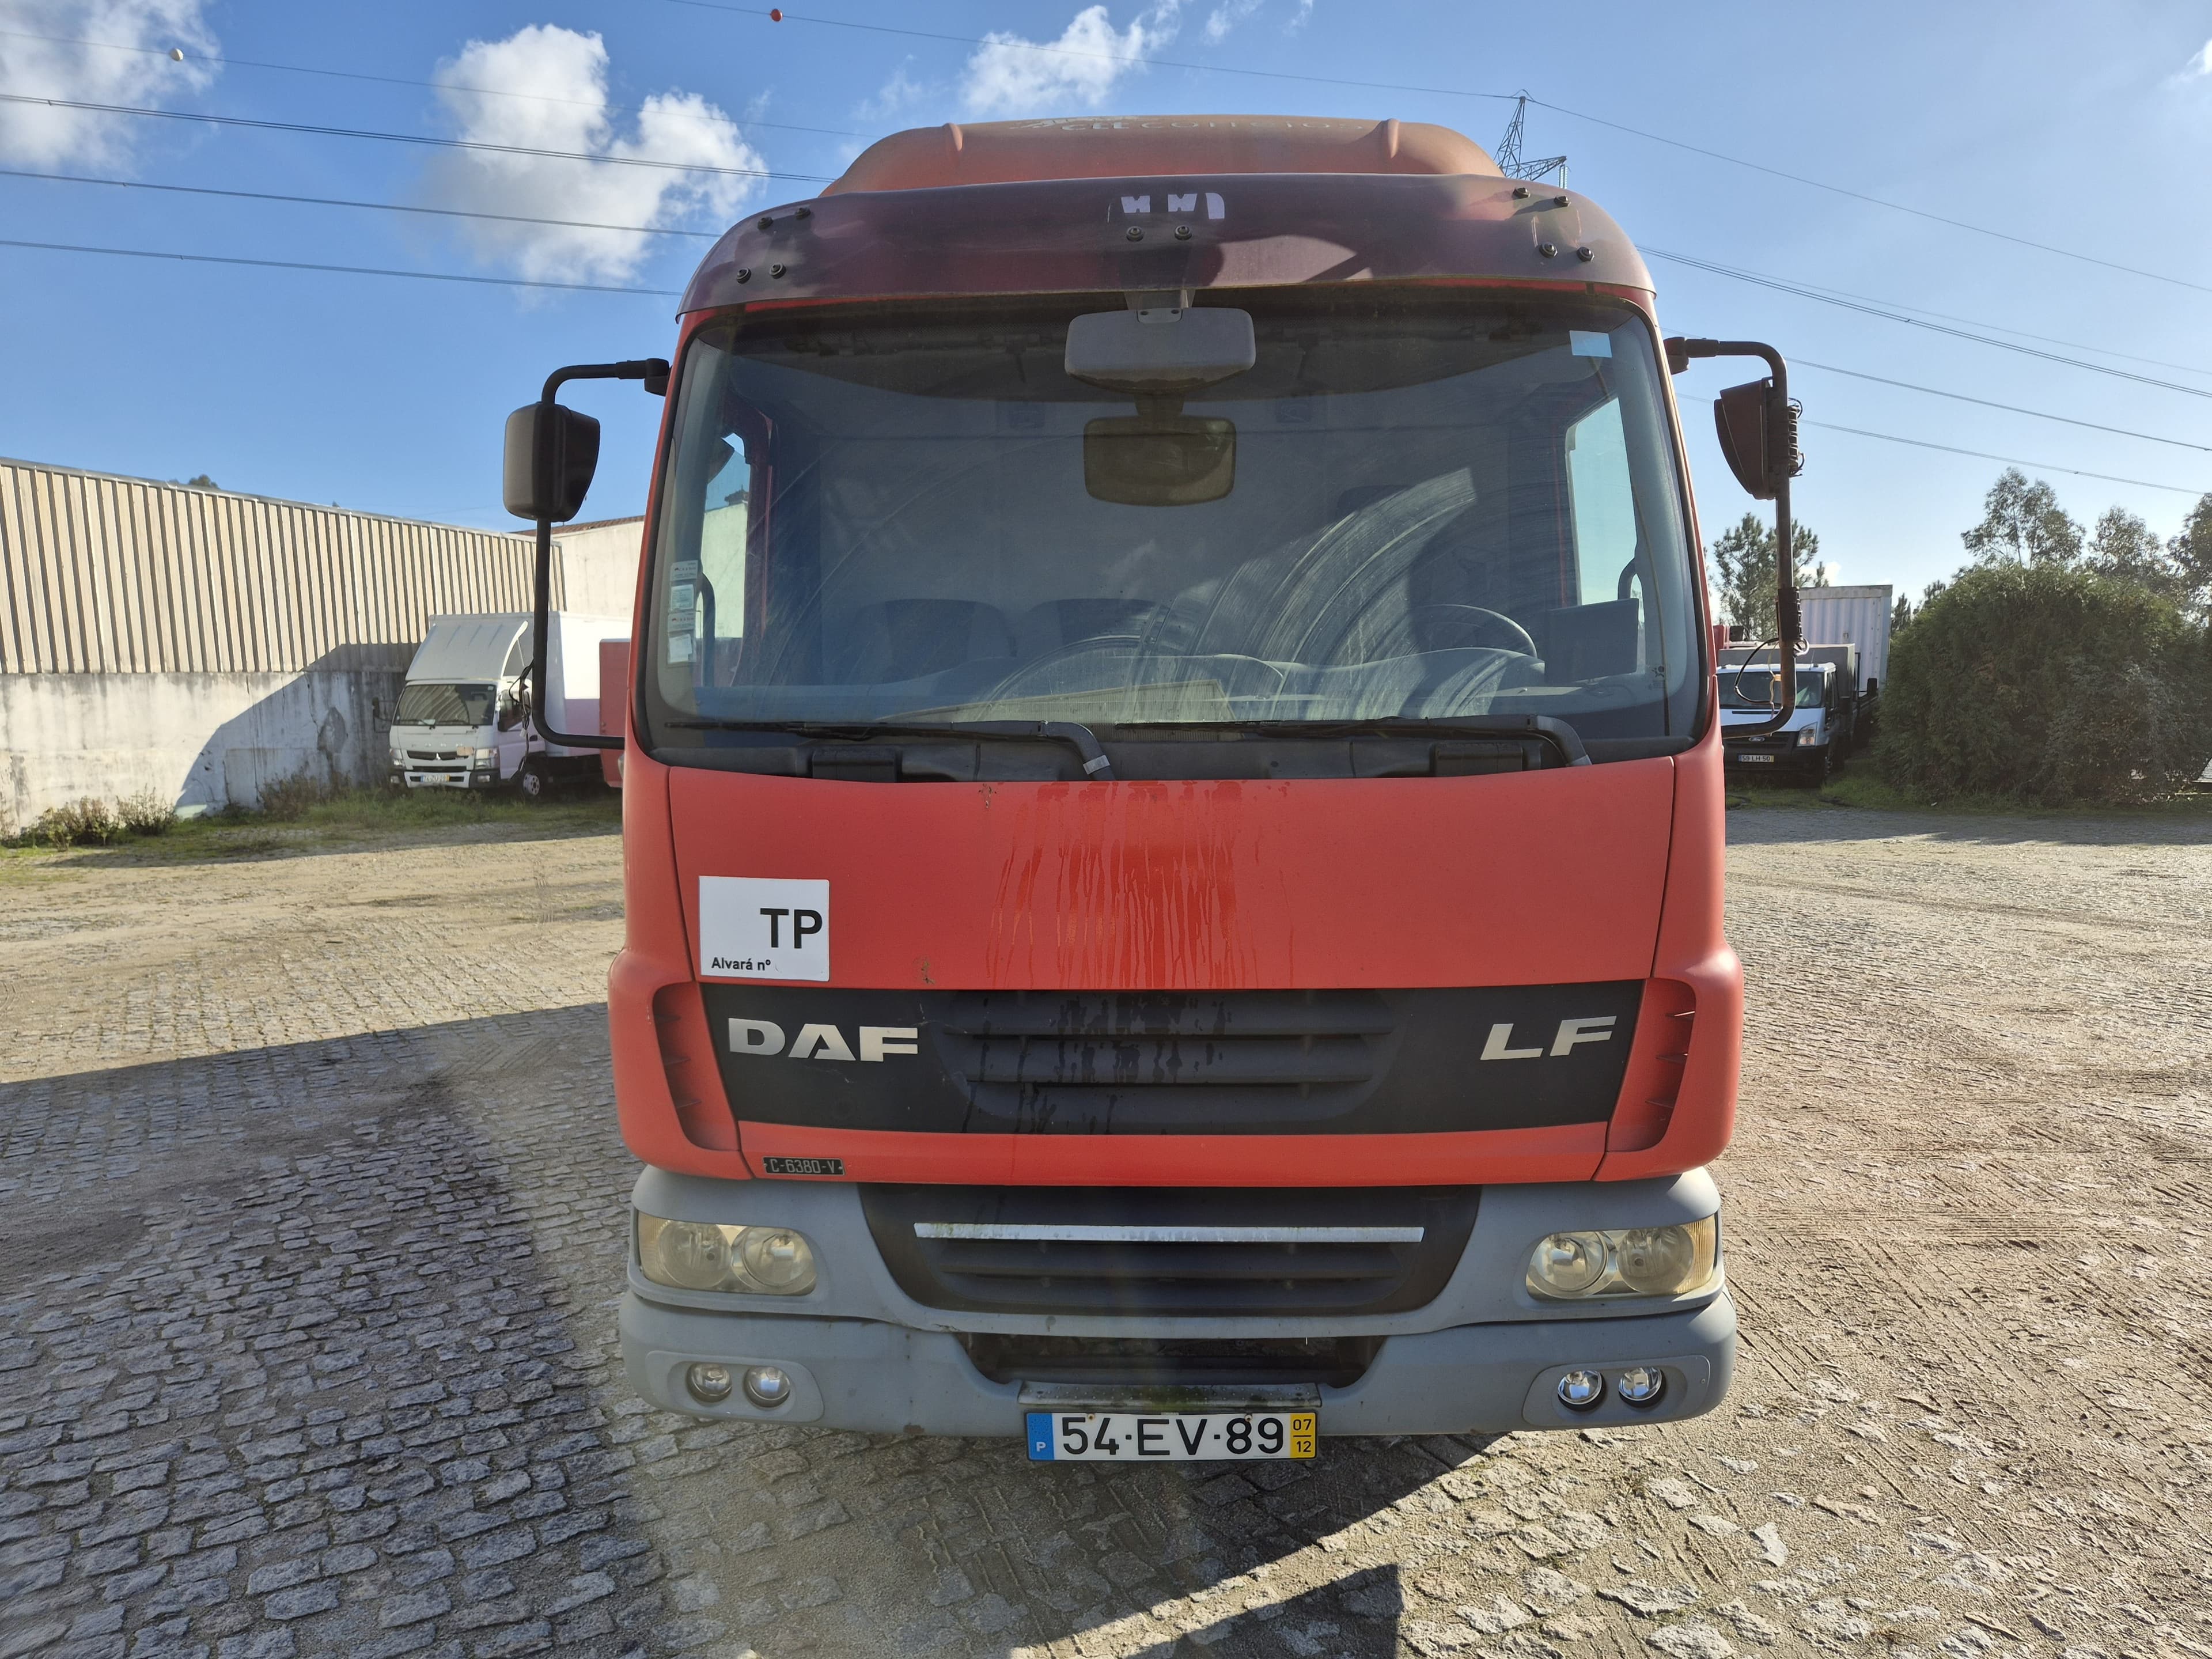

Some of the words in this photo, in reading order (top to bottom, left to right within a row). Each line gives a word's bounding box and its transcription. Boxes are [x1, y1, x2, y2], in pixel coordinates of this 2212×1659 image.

[760, 908, 823, 949] TP
[711, 957, 753, 971] Alvará
[728, 1017, 918, 1062] DAF
[1480, 1016, 1617, 1060] LF
[770, 1158, 835, 1173] C-6380-V
[1293, 1419, 1312, 1431] 07
[1036, 1441, 1046, 1452] P
[1297, 1441, 1312, 1452] 12
